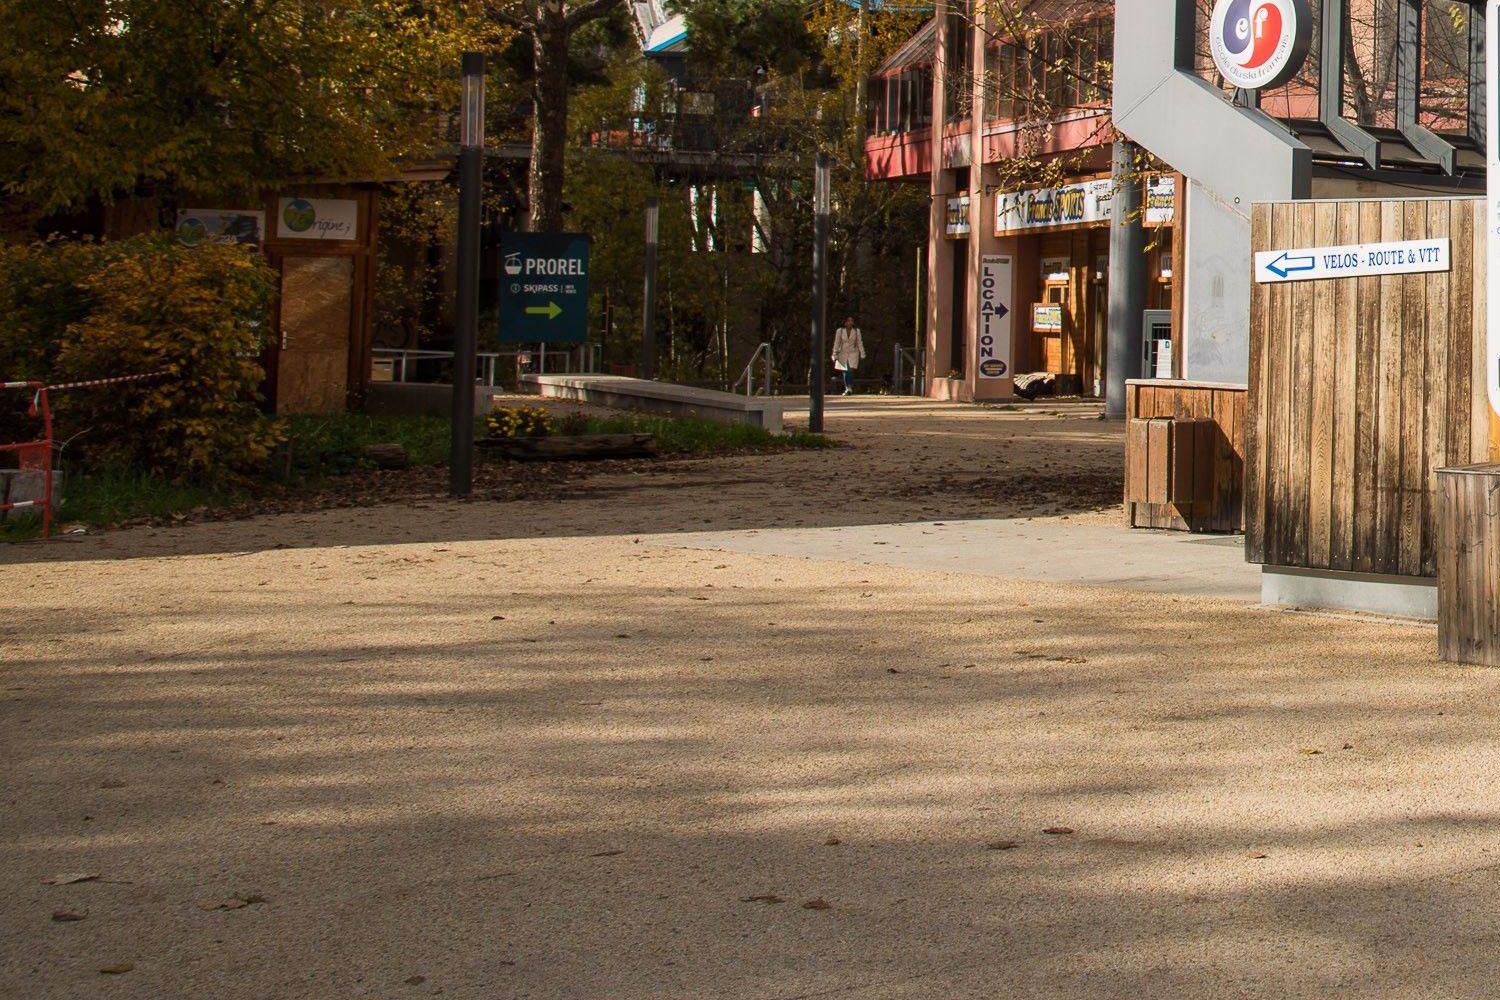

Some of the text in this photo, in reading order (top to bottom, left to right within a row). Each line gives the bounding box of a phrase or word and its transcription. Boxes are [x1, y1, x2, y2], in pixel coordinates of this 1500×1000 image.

[1053, 187, 1086, 221] SPORTS
[525, 258, 586, 275] PROREL
[1323, 252, 1358, 269] VELOS
[1368, 249, 1404, 266] ROUTE
[1407, 249, 1416, 264] &
[1419, 247, 1441, 263] VTT
[523, 284, 559, 293] SKIPASS
[981, 266, 996, 358] LOCATION
